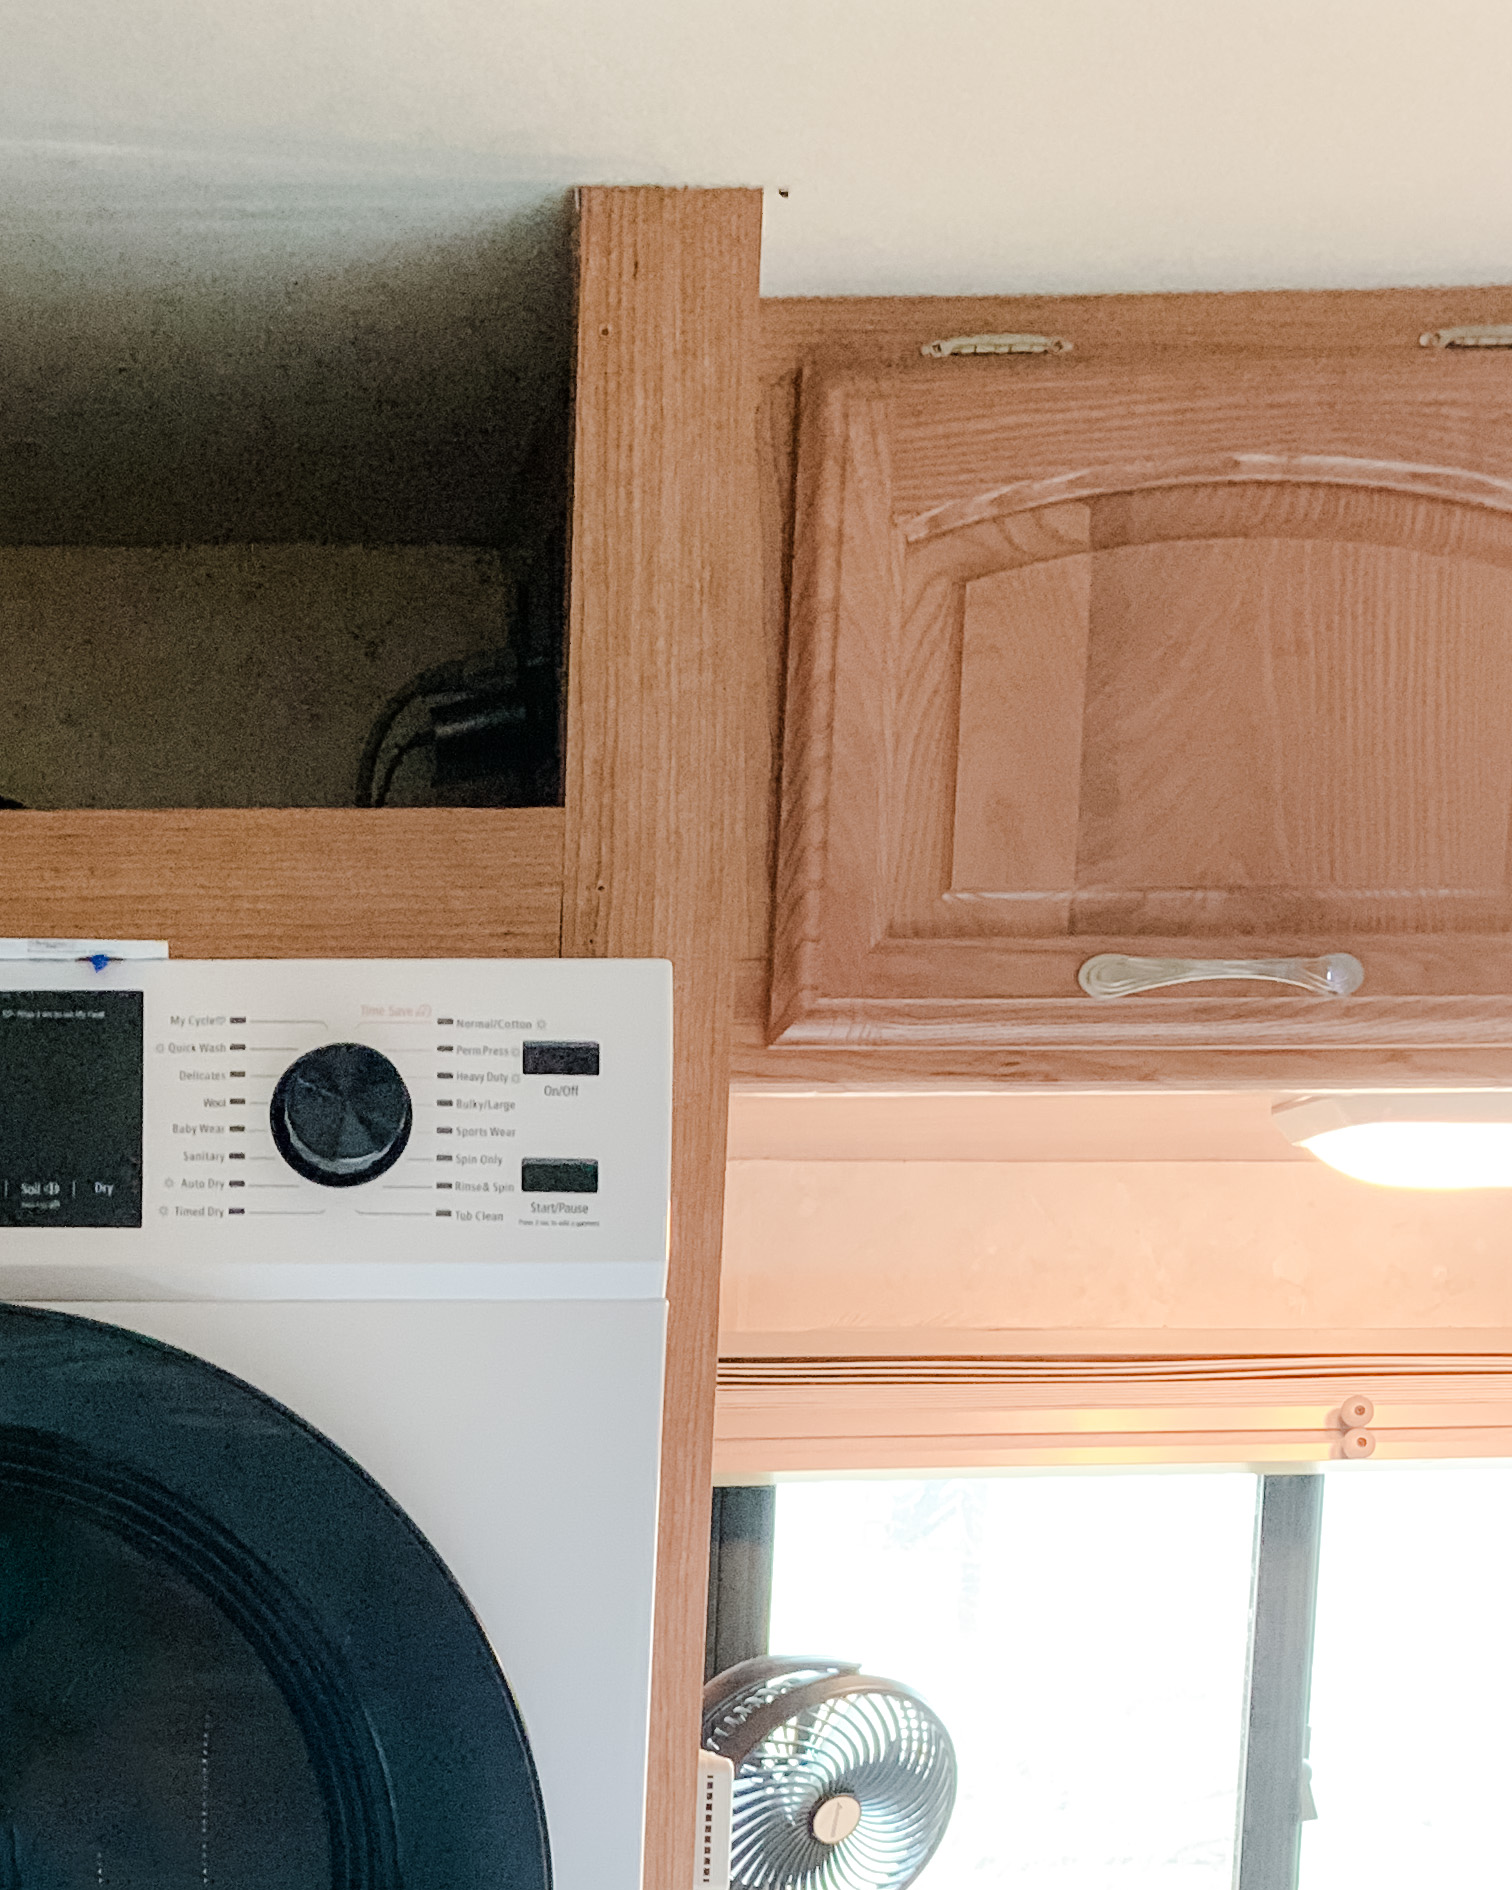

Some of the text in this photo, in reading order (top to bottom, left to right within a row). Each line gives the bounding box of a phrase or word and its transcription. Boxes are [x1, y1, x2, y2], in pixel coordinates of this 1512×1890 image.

[360, 1004, 414, 1017] Time Save
[170, 1015, 215, 1027] My Cycle
[456, 1019, 532, 1030] Normal/Cotton
[168, 1042, 227, 1054] Quick Wash
[456, 1045, 510, 1056] Perm Press
[179, 1069, 227, 1081] Delicates
[456, 1071, 509, 1083] Heavy Duty
[543, 1084, 580, 1098] On/Off
[203, 1098, 227, 1108] Wool
[456, 1099, 516, 1112] Bulky/Large
[172, 1123, 225, 1135] Baby Wear
[455, 1127, 516, 1139] Sports Wear
[183, 1151, 226, 1163] Sanitary
[455, 1154, 503, 1167] Spin Only
[21, 1181, 41, 1196] Soil
[94, 1181, 114, 1197] Dry
[181, 1178, 225, 1191] Auto Dry
[492, 1182, 515, 1195] Spin
[174, 1205, 224, 1218] Timed Dry
[530, 1201, 589, 1215] Start/Pause
[454, 1210, 504, 1222] Tub Clean
